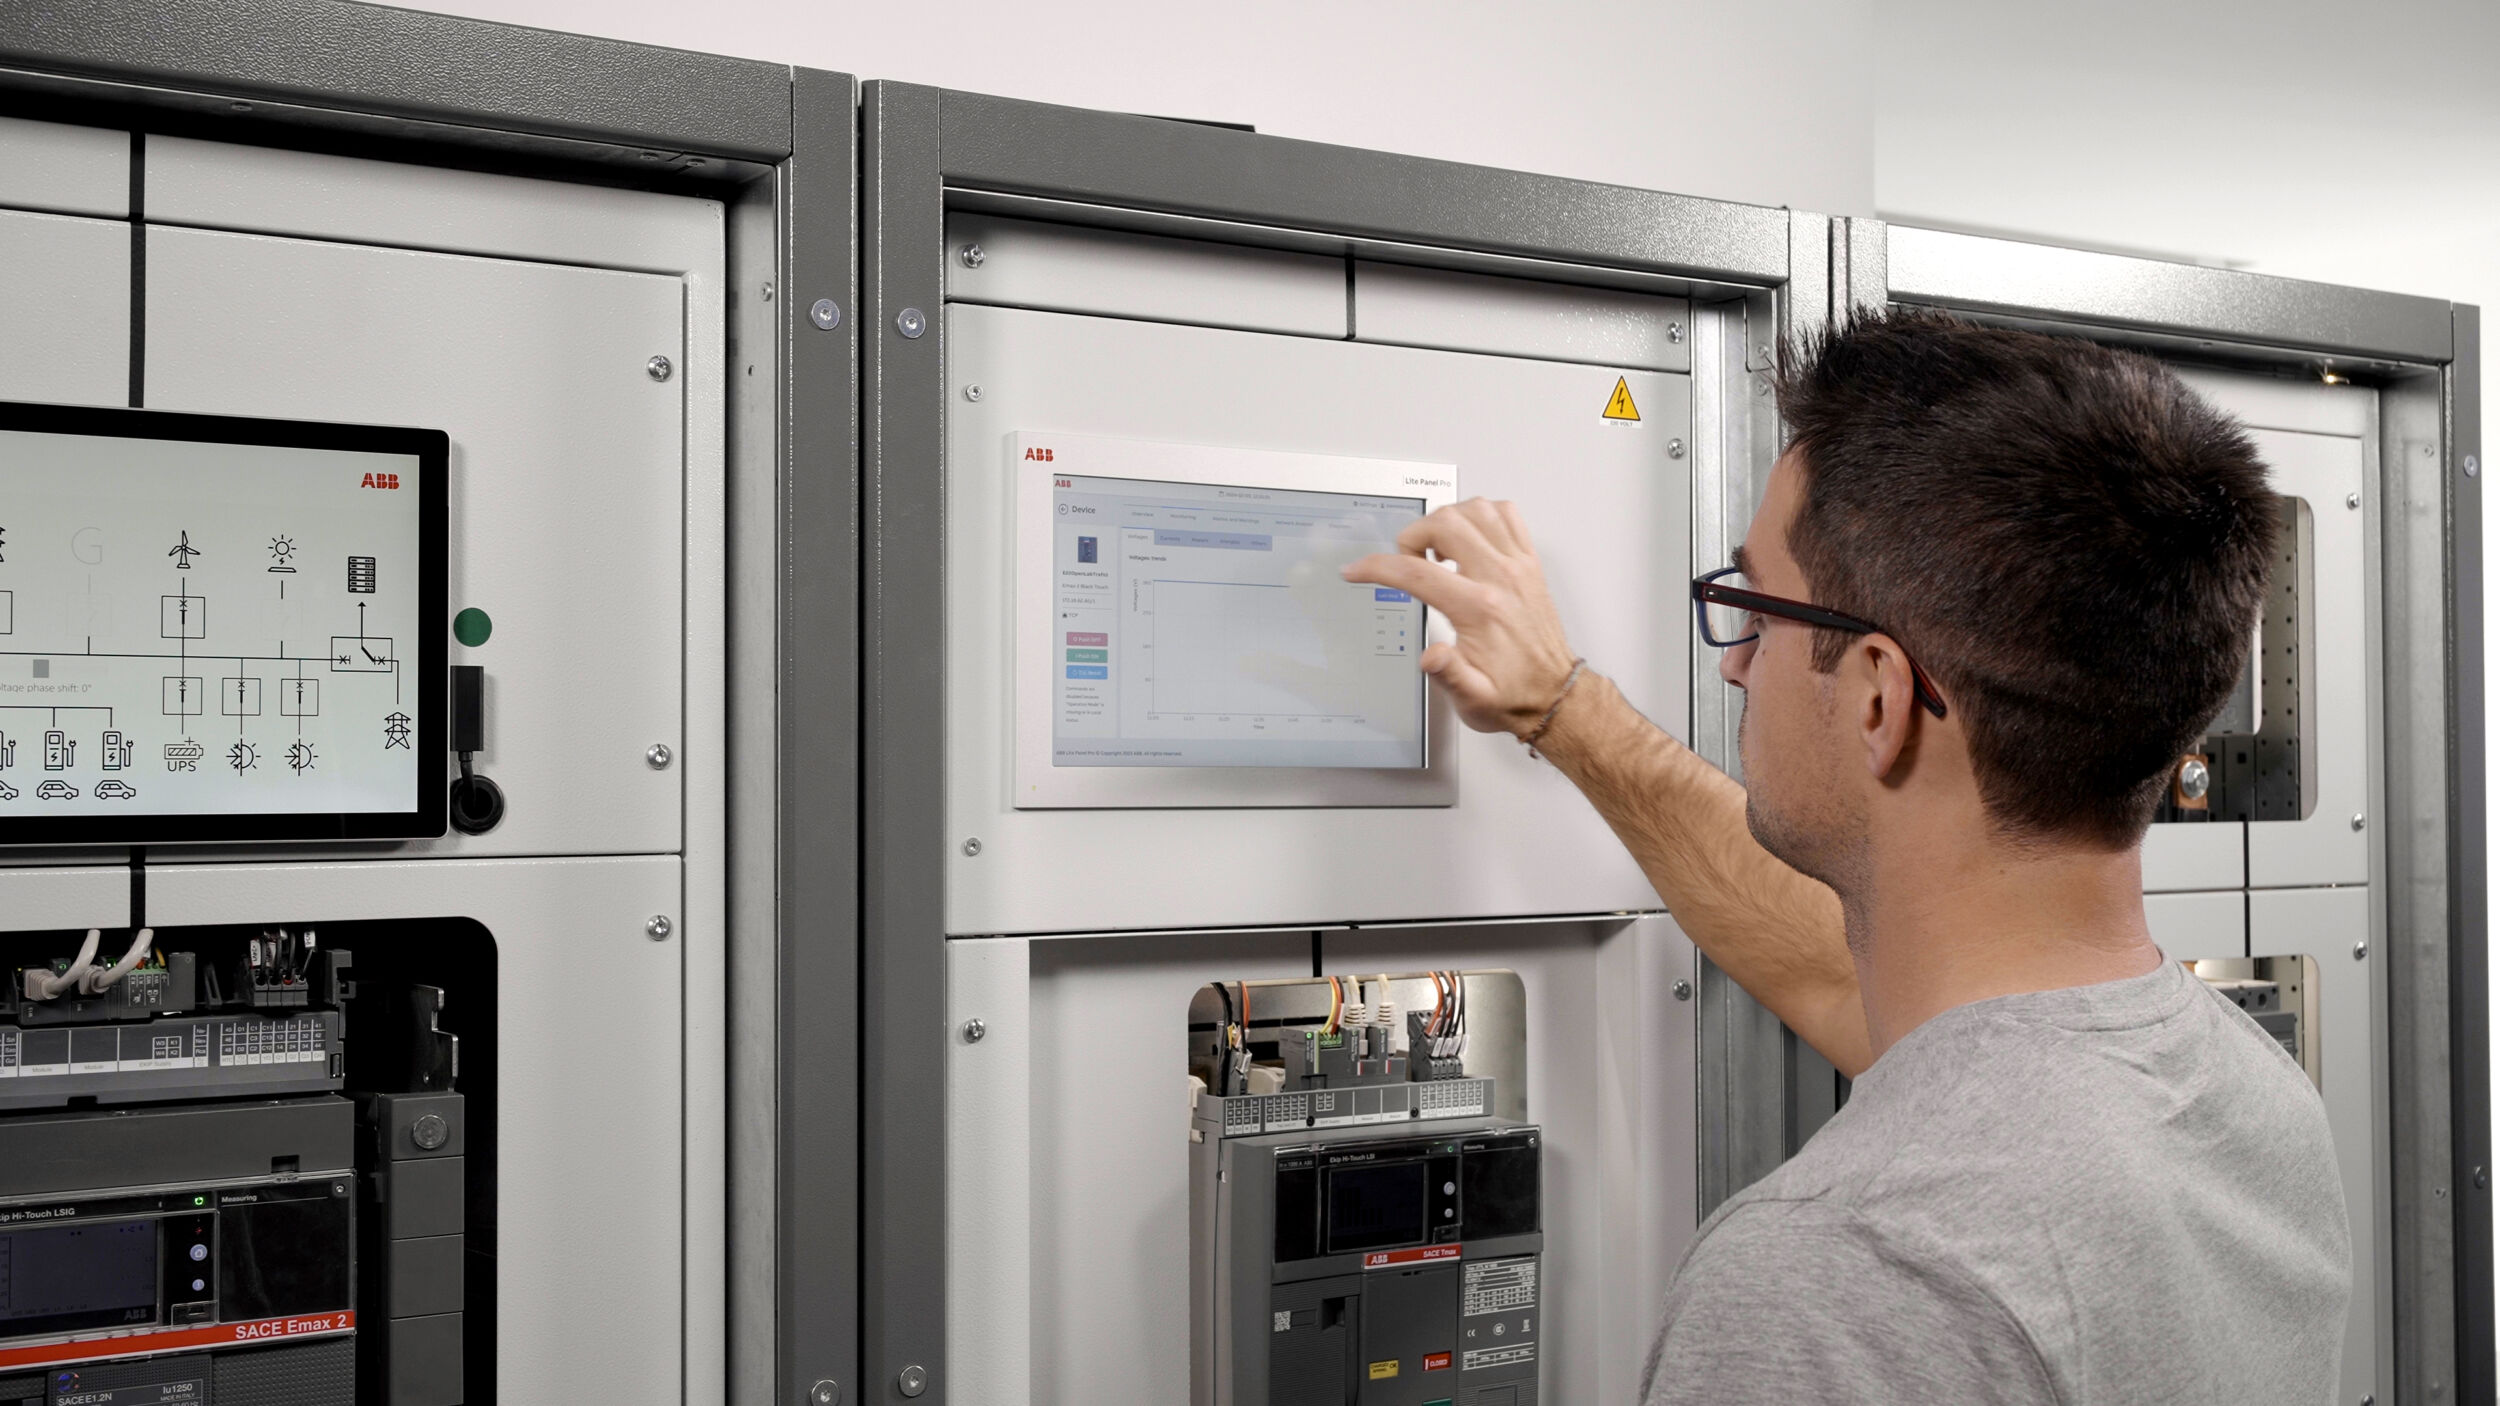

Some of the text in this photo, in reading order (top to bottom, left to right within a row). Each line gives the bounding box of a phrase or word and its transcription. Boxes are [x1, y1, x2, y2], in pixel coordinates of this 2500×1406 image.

[1025, 447, 1053, 462] ABB
[361, 472, 400, 490] ABB
[1055, 479, 1071, 488] ABB
[1405, 477, 1418, 485] Lite
[1420, 478, 1438, 486] Panel
[1072, 506, 1096, 514] Device
[0, 683, 24, 693] ltage
[27, 683, 55, 694] phase
[168, 761, 196, 772] UPS
[1342, 1154, 1365, 1162] Hi-Touch
[221, 1194, 257, 1203] Measuring
[12, 1208, 52, 1220] Hi-Touch
[54, 1207, 75, 1217] LSIG
[1371, 1249, 1456, 1265] ABB SACE Tmax
[124, 1308, 147, 1321] ABB
[235, 1314, 346, 1340] SACE Emax 2
[58, 1392, 112, 1406] SACE E1.2N
